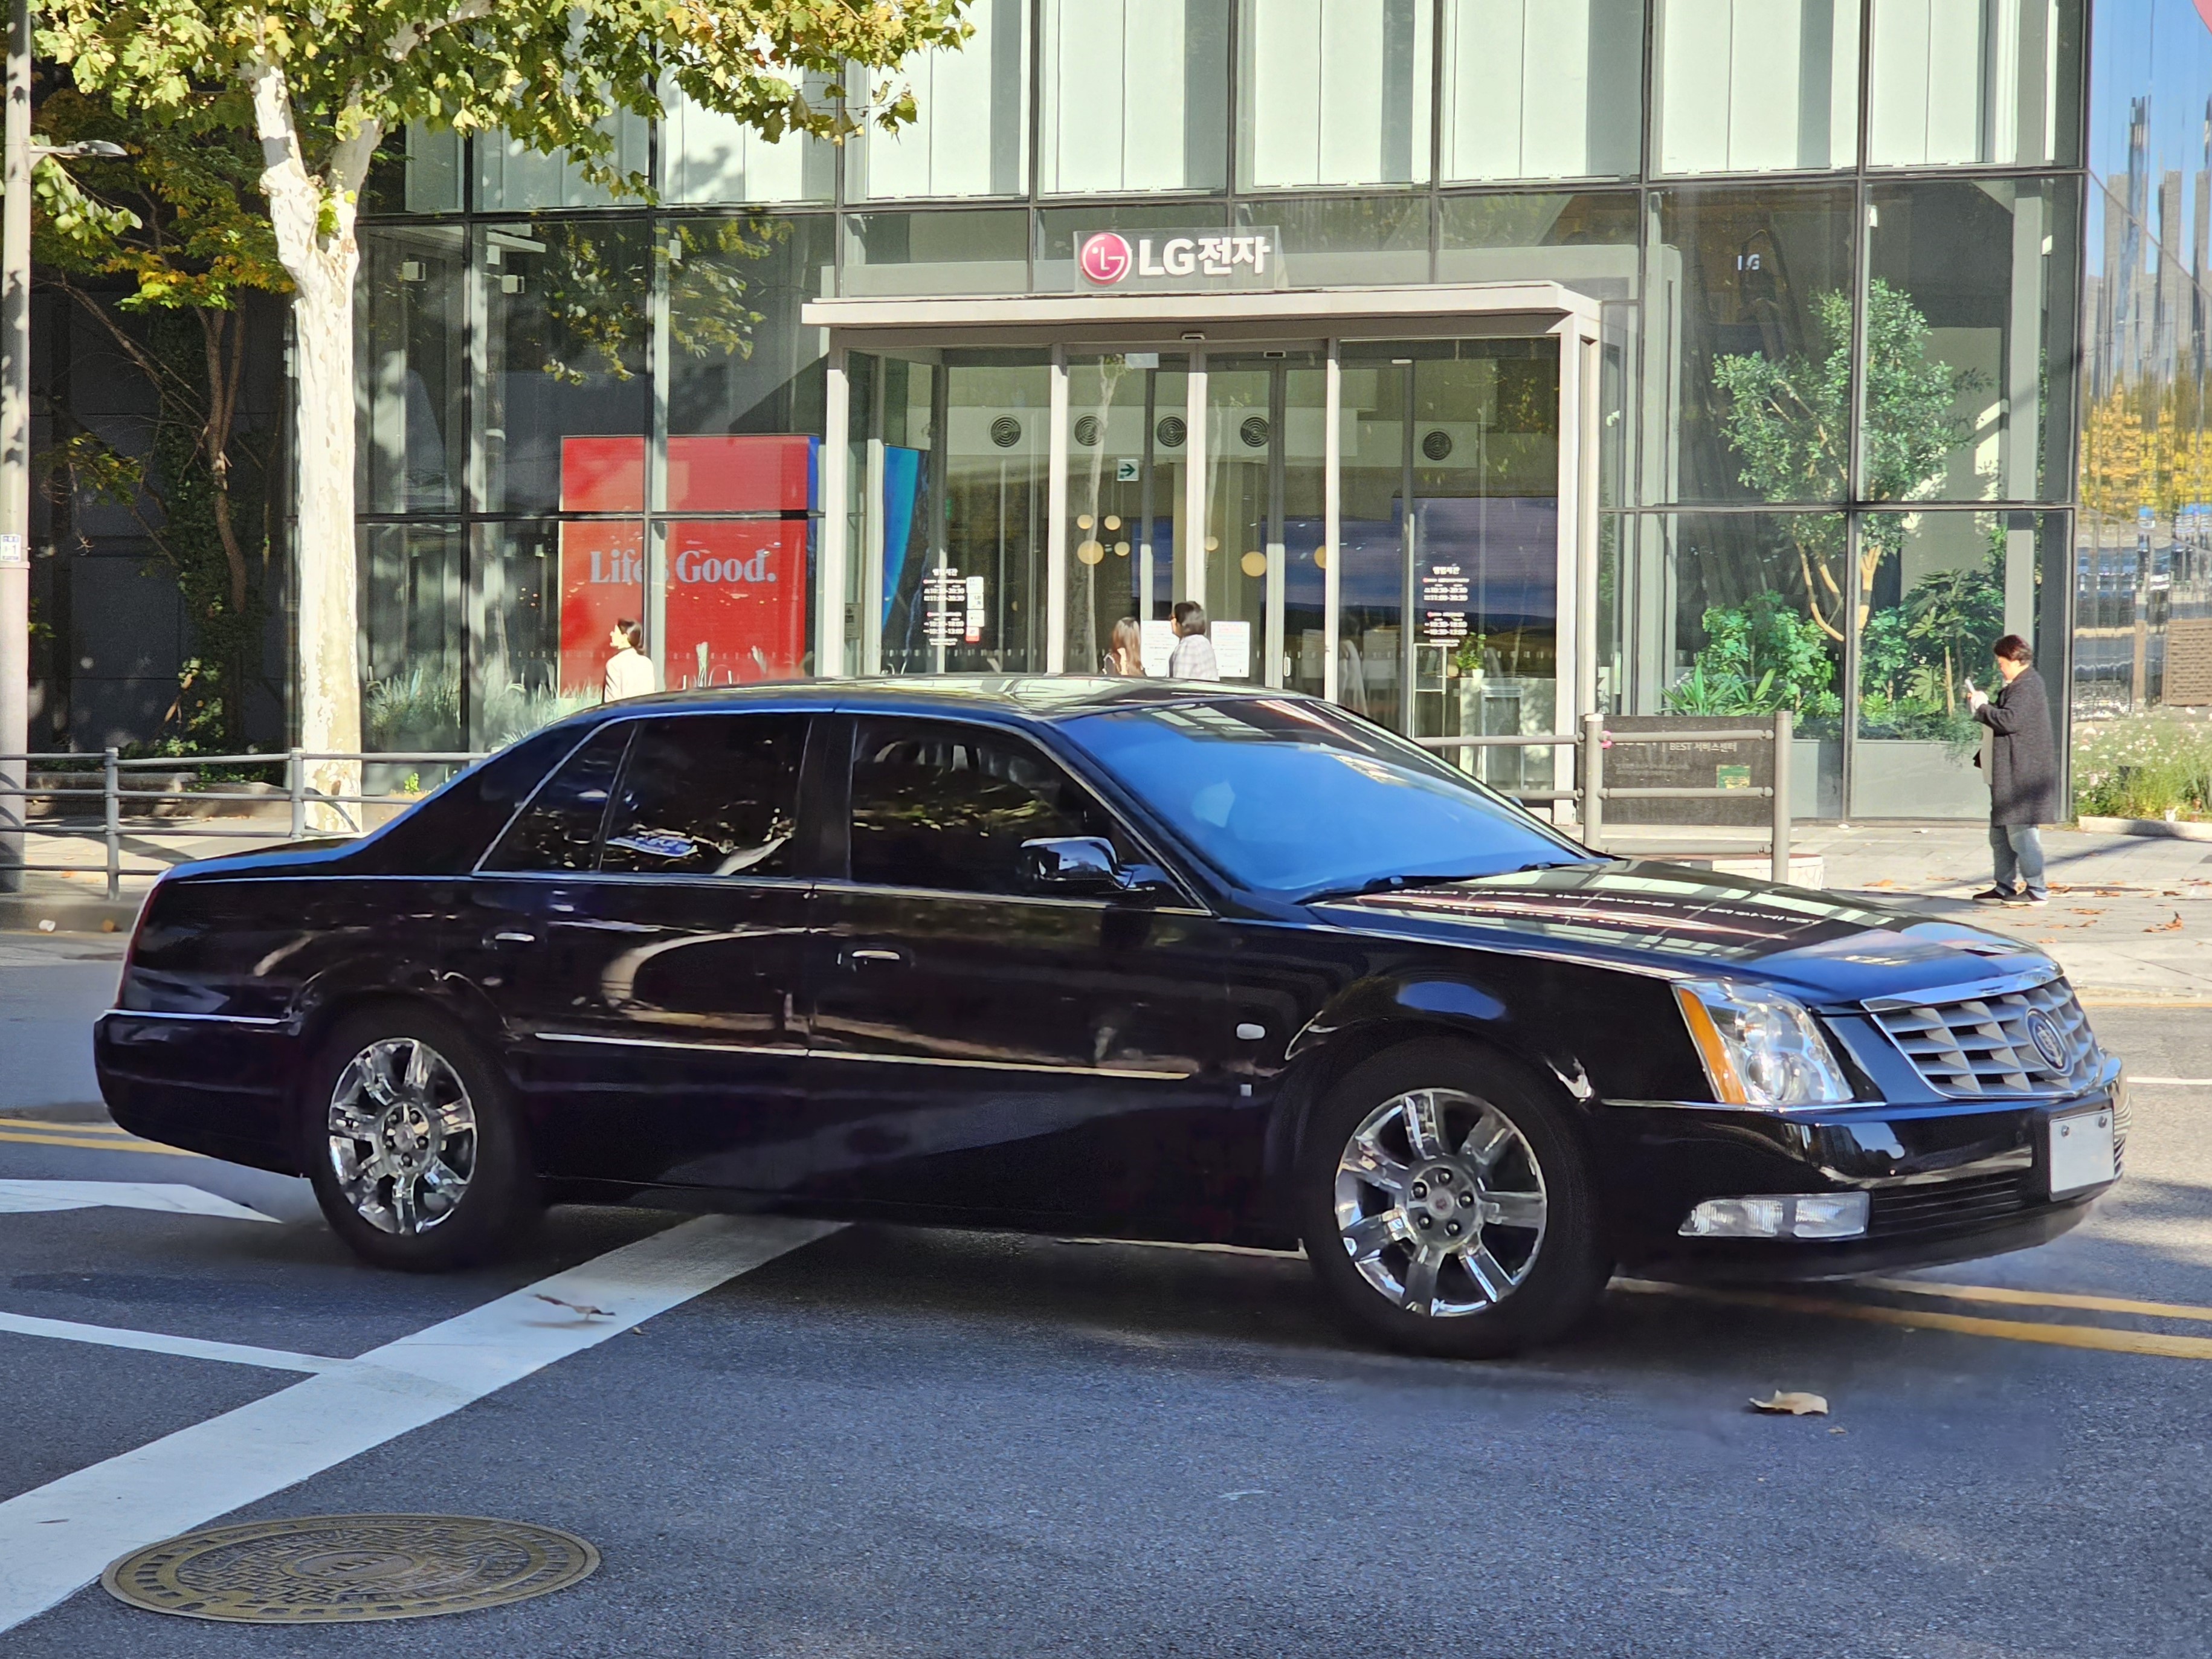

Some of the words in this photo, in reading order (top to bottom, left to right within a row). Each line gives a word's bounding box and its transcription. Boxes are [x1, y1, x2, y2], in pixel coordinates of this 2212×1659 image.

[1138, 236, 1271, 276] LG전자
[590, 549, 669, 583] Life
[676, 549, 777, 583] Good.
[1669, 743, 1692, 751] BEST
[1694, 742, 1738, 753] 서비스센터
